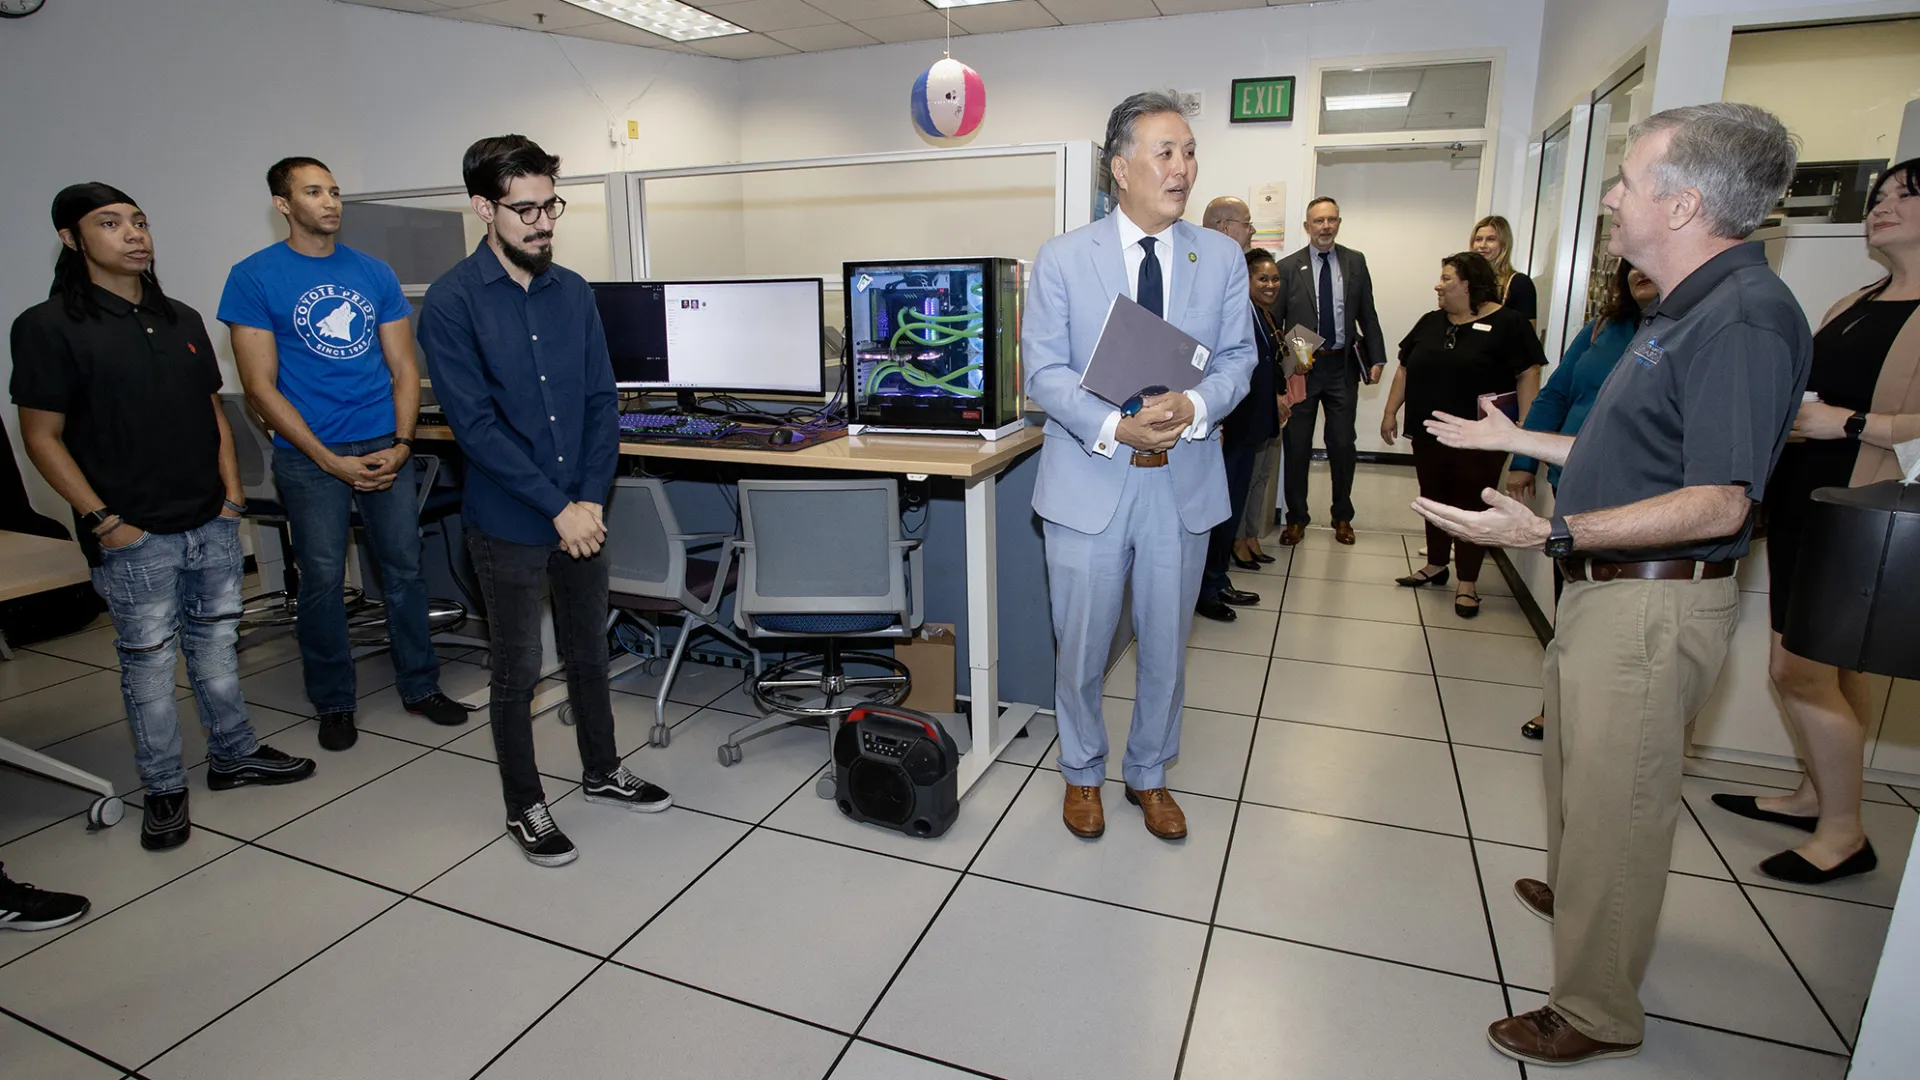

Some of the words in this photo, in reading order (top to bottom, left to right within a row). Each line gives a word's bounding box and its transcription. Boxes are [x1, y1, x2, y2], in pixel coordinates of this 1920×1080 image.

[1242, 84, 1285, 115] EXIT
[297, 287, 334, 326] COYOTE
[342, 290, 374, 320] PRIDE
[316, 343, 345, 356] SINCE
[348, 340, 367, 355] 1965
